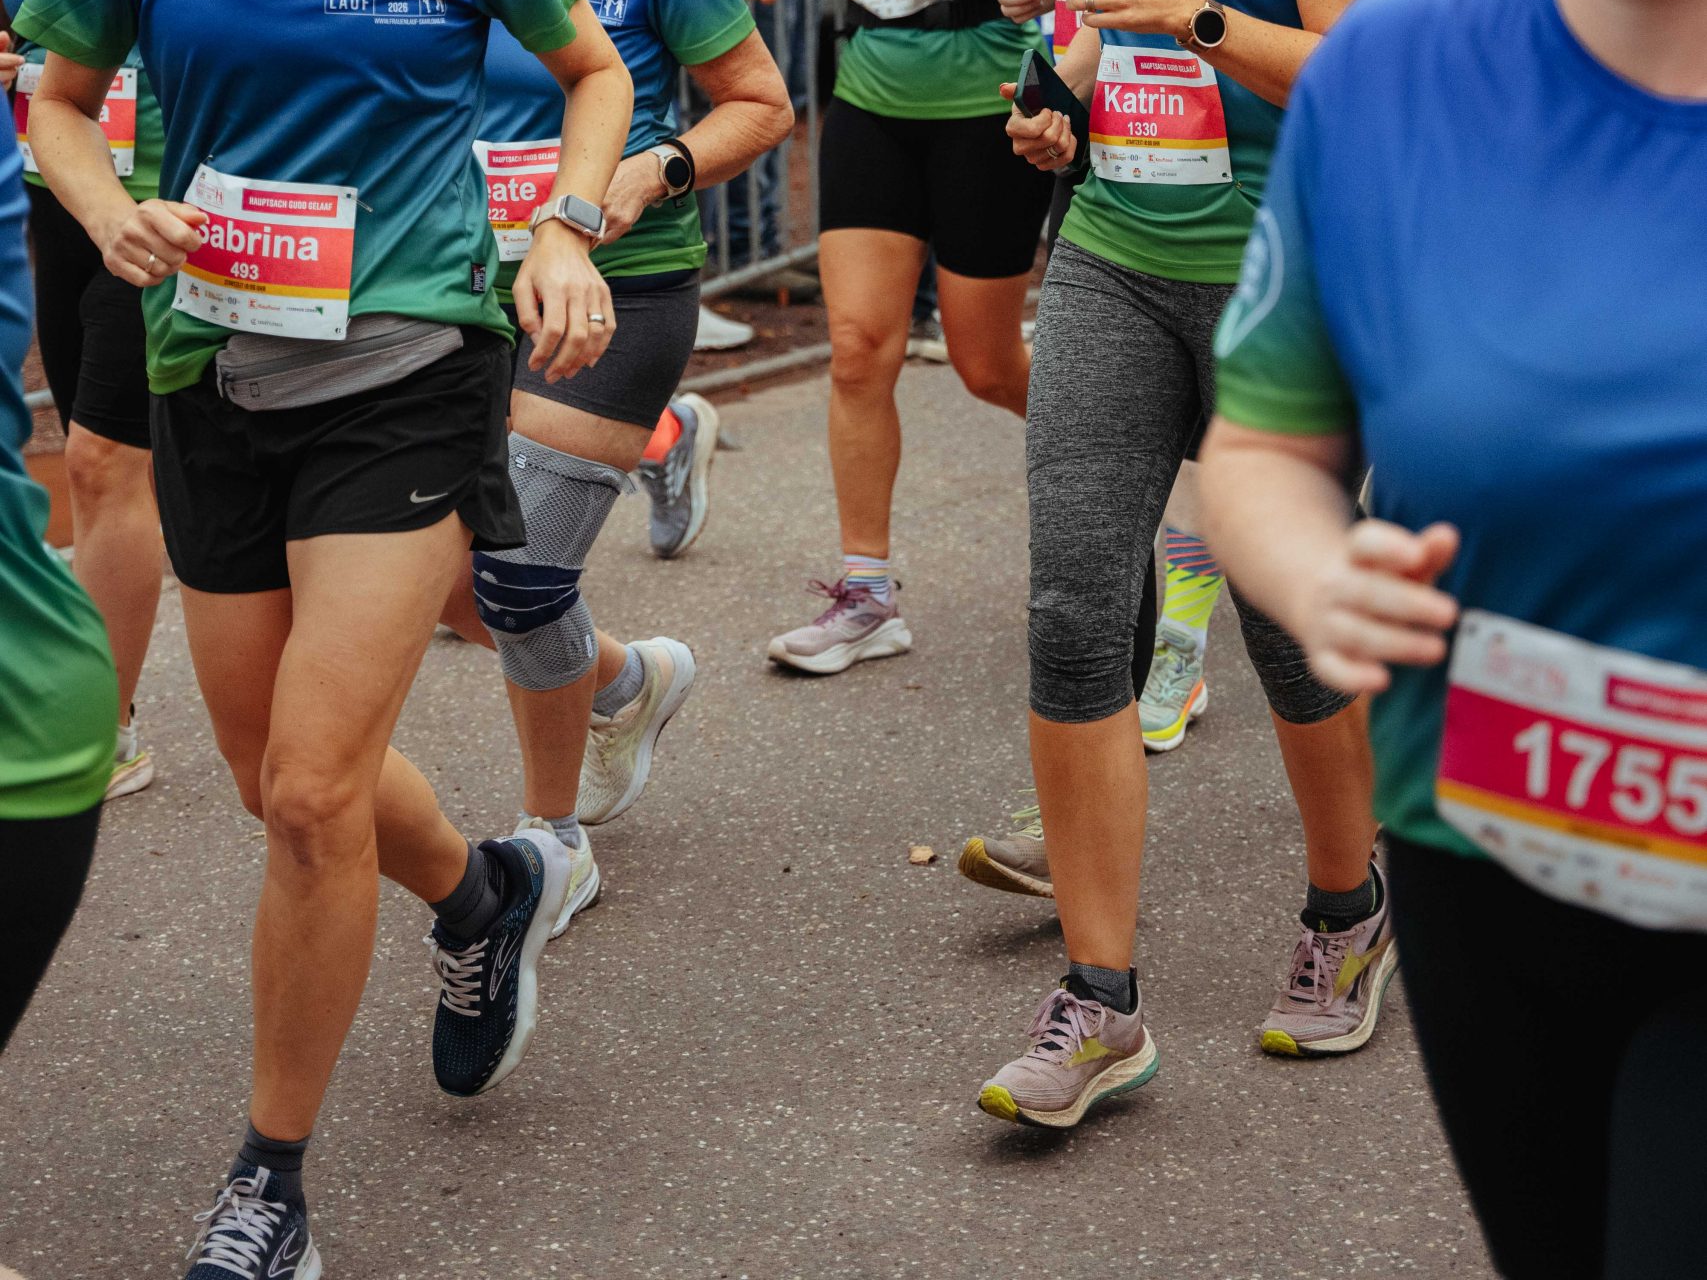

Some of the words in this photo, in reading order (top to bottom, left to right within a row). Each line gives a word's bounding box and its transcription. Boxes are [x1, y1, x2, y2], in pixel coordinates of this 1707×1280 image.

[1104, 84, 1184, 116] Katrin
[1127, 121, 1158, 137] 1330
[487, 178, 537, 202] ate
[249, 196, 287, 209] HAUPTSACH
[230, 261, 260, 280] 493
[1513, 720, 1707, 836] 1755
